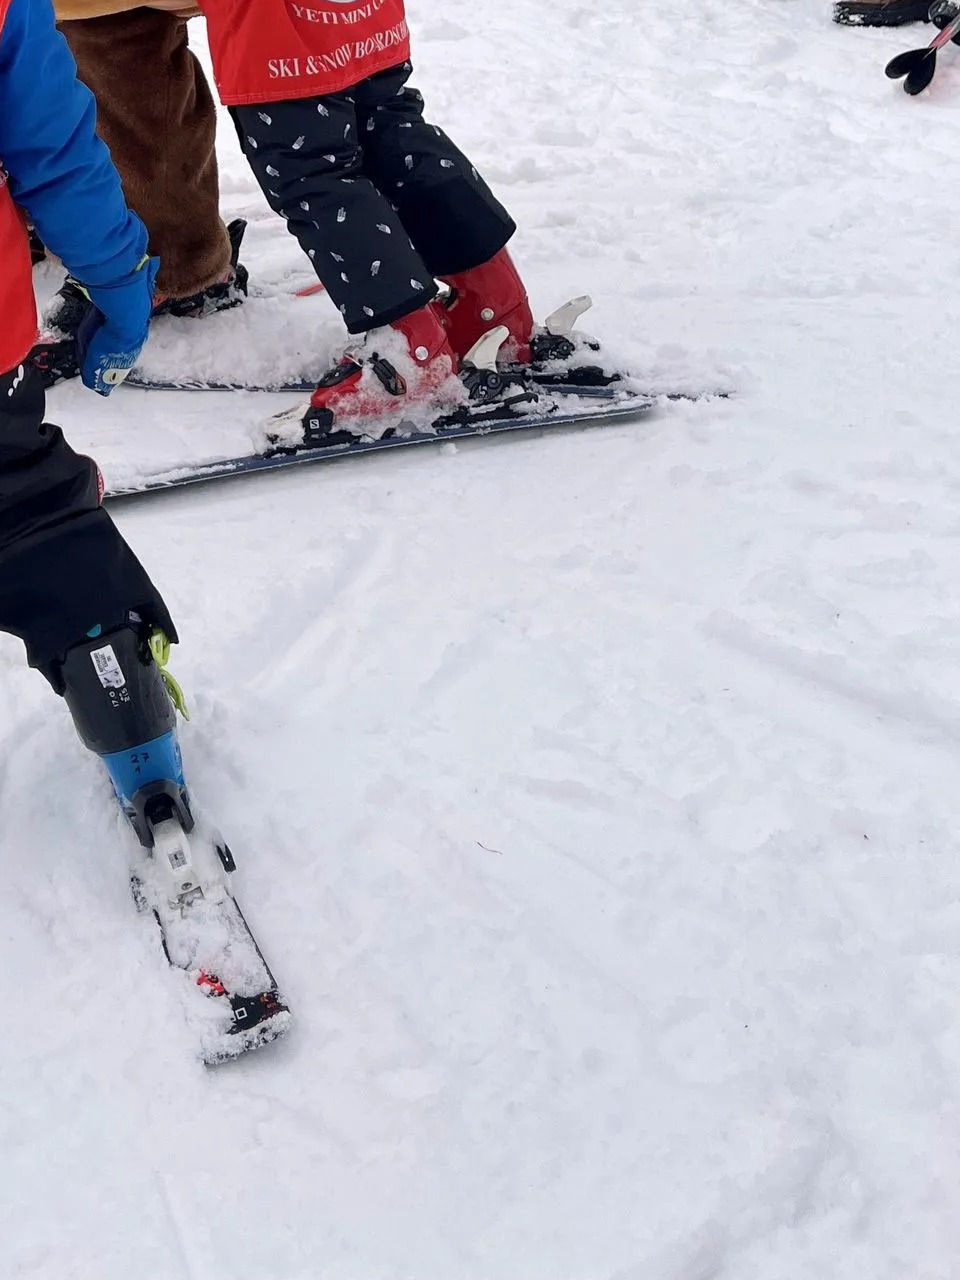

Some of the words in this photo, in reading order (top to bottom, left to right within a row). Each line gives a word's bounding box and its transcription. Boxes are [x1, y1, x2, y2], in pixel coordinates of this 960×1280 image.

[290, 2, 339, 25] YETI
[340, 4, 372, 25] MINI
[268, 58, 301, 79] SKI
